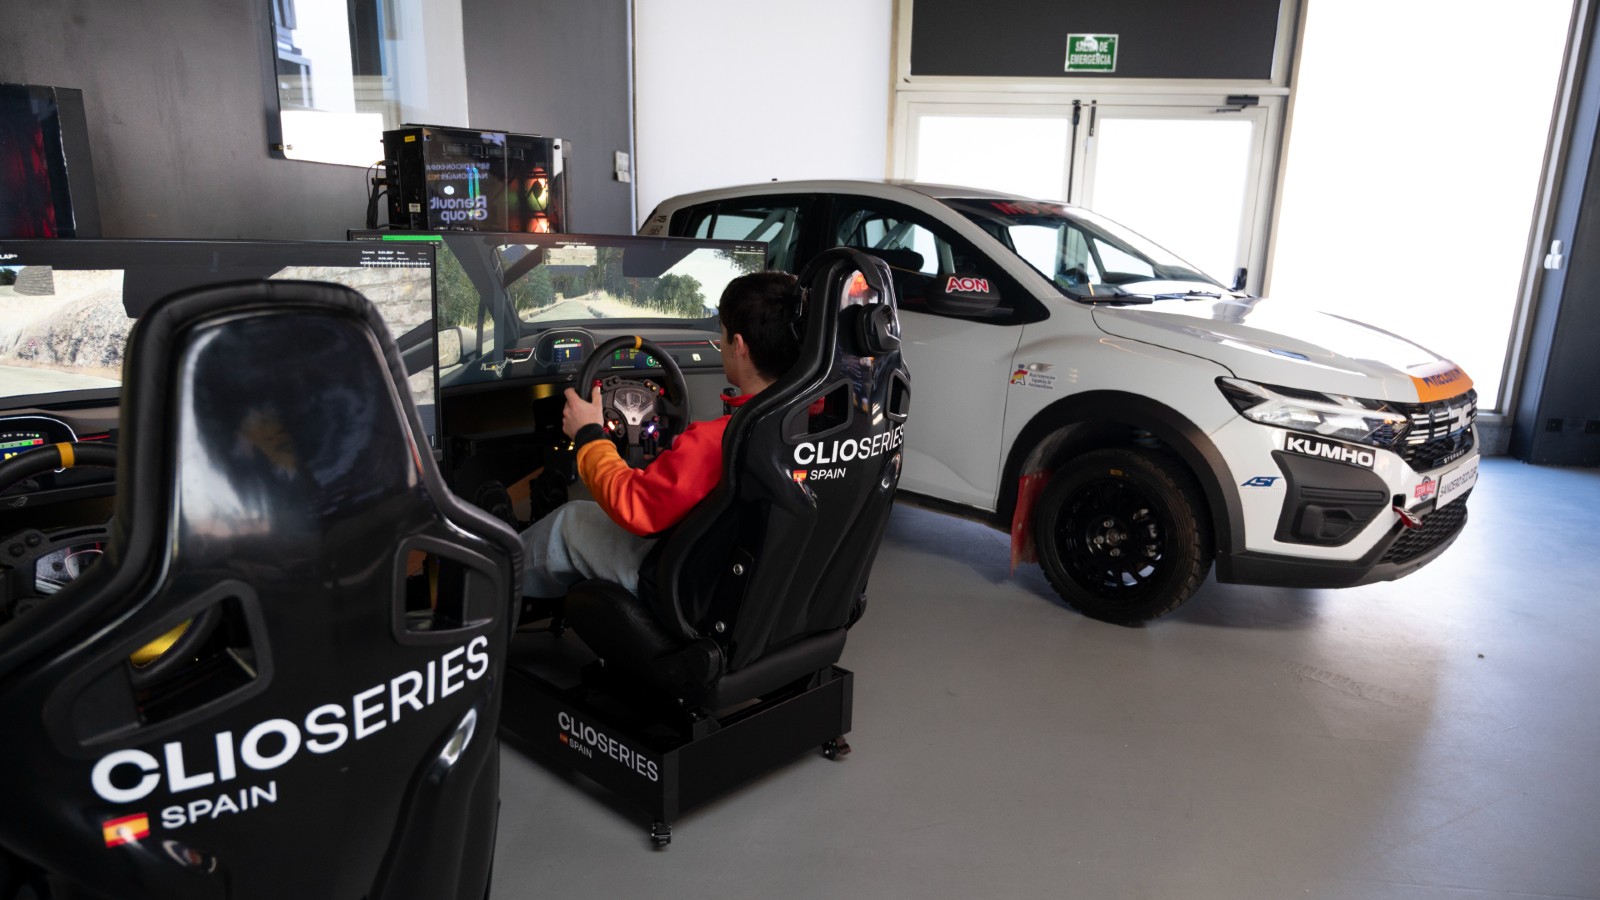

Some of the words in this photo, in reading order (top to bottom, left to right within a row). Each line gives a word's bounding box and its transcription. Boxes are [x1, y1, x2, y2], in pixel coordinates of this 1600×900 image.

[1099, 41, 1109, 52] DE
[1070, 54, 1111, 65] EMERGENCIA
[945, 276, 989, 293] AON
[794, 424, 904, 465] CLIOSERIES
[1287, 437, 1374, 467] KUMHO
[810, 467, 847, 480] SPAIN
[91, 635, 489, 803] CLIOSERIES
[558, 711, 659, 782] CLIOSERIES
[569, 738, 593, 759] SPAIN
[161, 780, 277, 829] SPAIN
